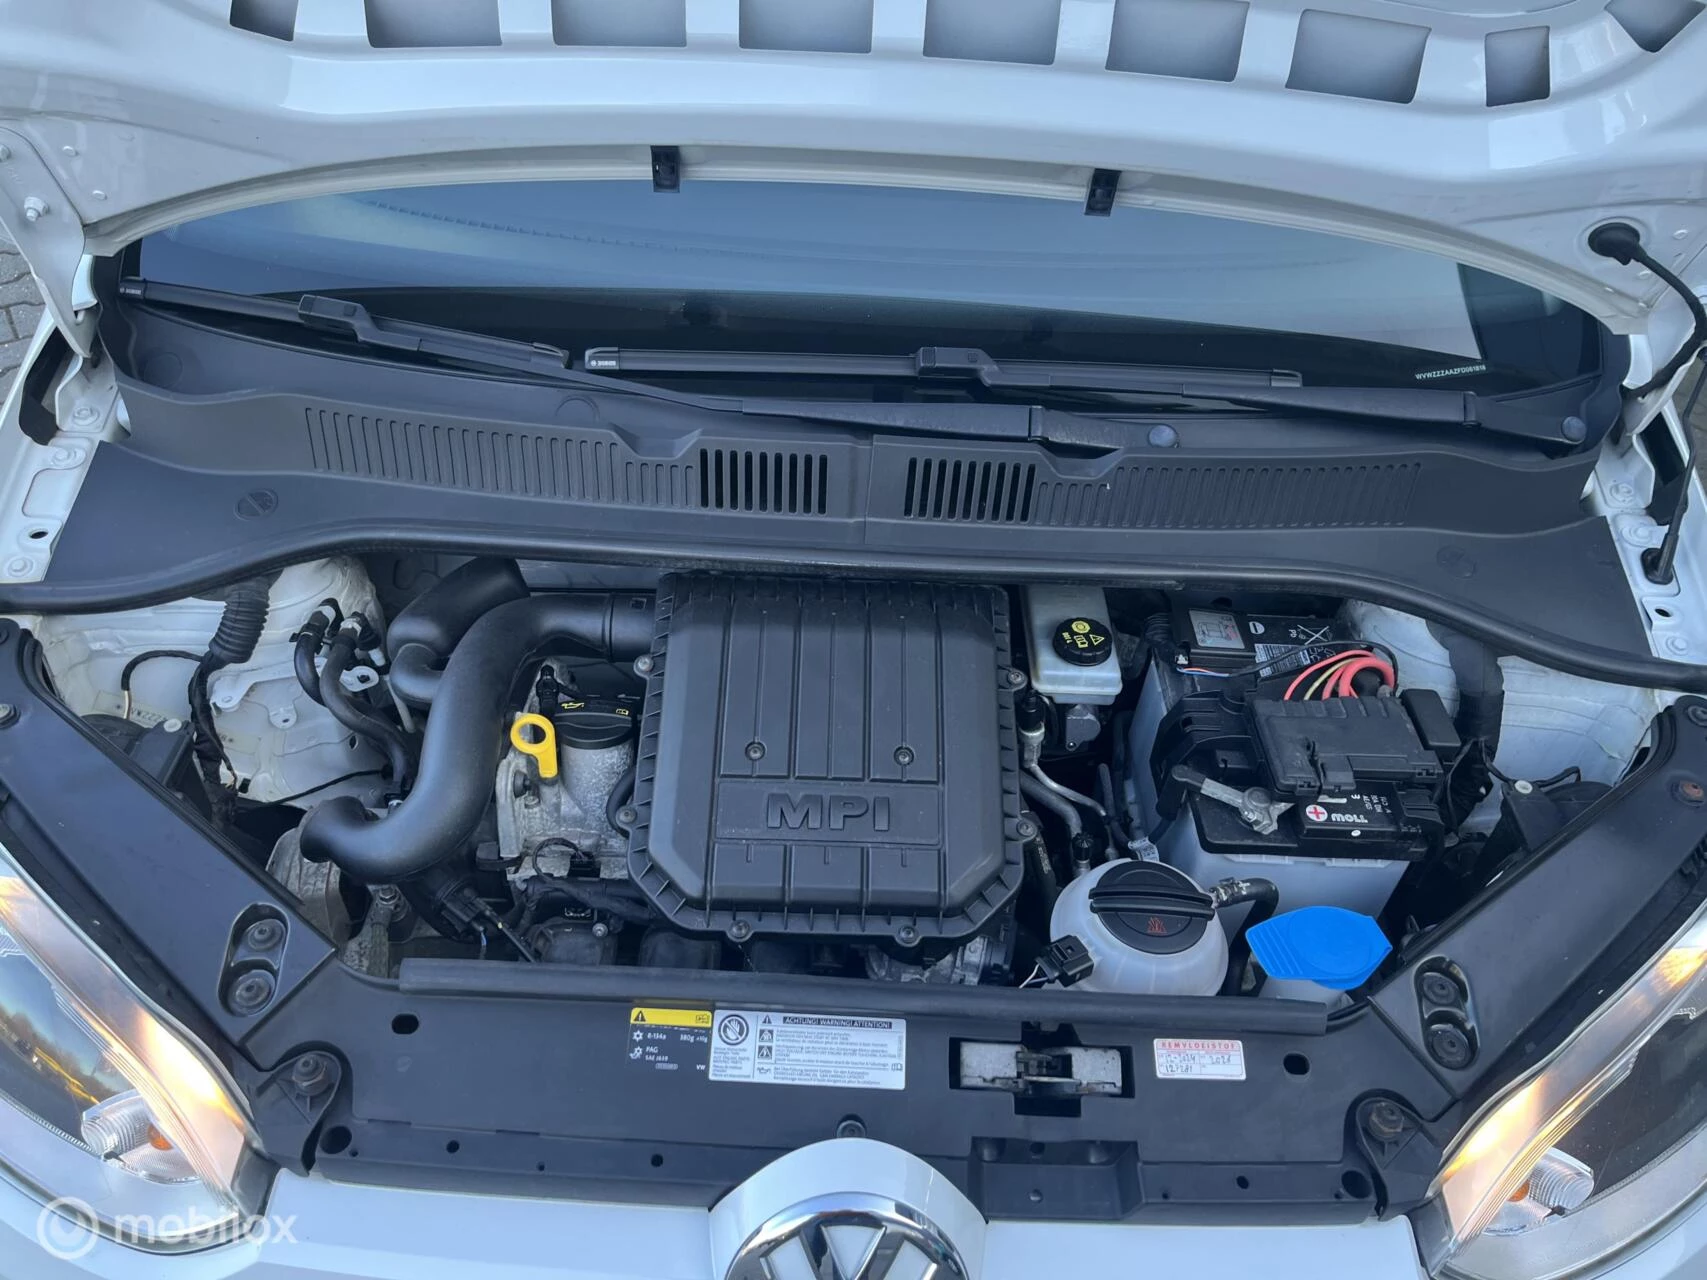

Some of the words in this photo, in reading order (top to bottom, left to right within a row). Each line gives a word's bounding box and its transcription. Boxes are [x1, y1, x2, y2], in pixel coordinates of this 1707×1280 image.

[767, 792, 890, 832] MPI
[785, 1017, 818, 1025] ACHTUNG!
[820, 1018, 853, 1027] WARNING!
[853, 1020, 891, 1029] ATTENTION!
